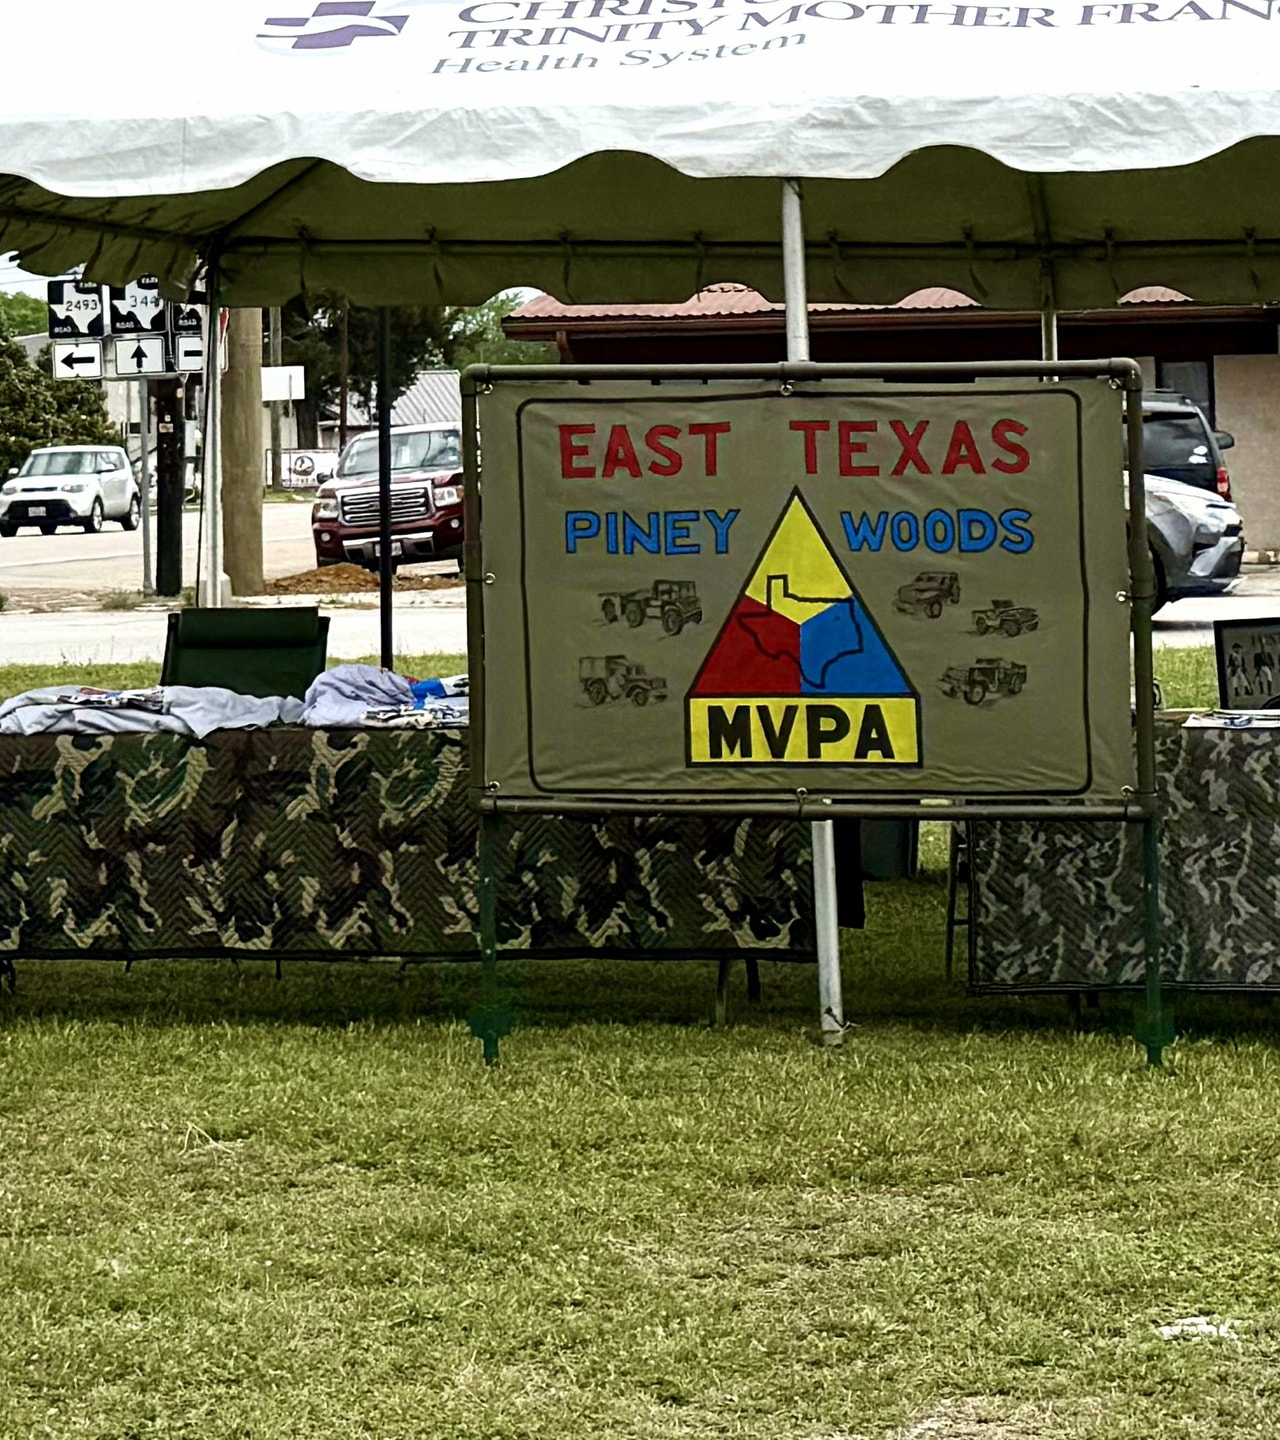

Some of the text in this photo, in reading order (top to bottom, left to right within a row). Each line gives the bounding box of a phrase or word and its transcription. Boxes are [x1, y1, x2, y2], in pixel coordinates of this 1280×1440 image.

[448, 15, 728, 50] TRINITY
[741, 0, 1061, 31] MOTHER
[431, 33, 807, 74] Health System
[65, 299, 98, 312] 2493
[558, 419, 1031, 478] EAST TEXAS
[564, 507, 1034, 555] PINEY WOODS
[707, 704, 895, 759] MVPA
